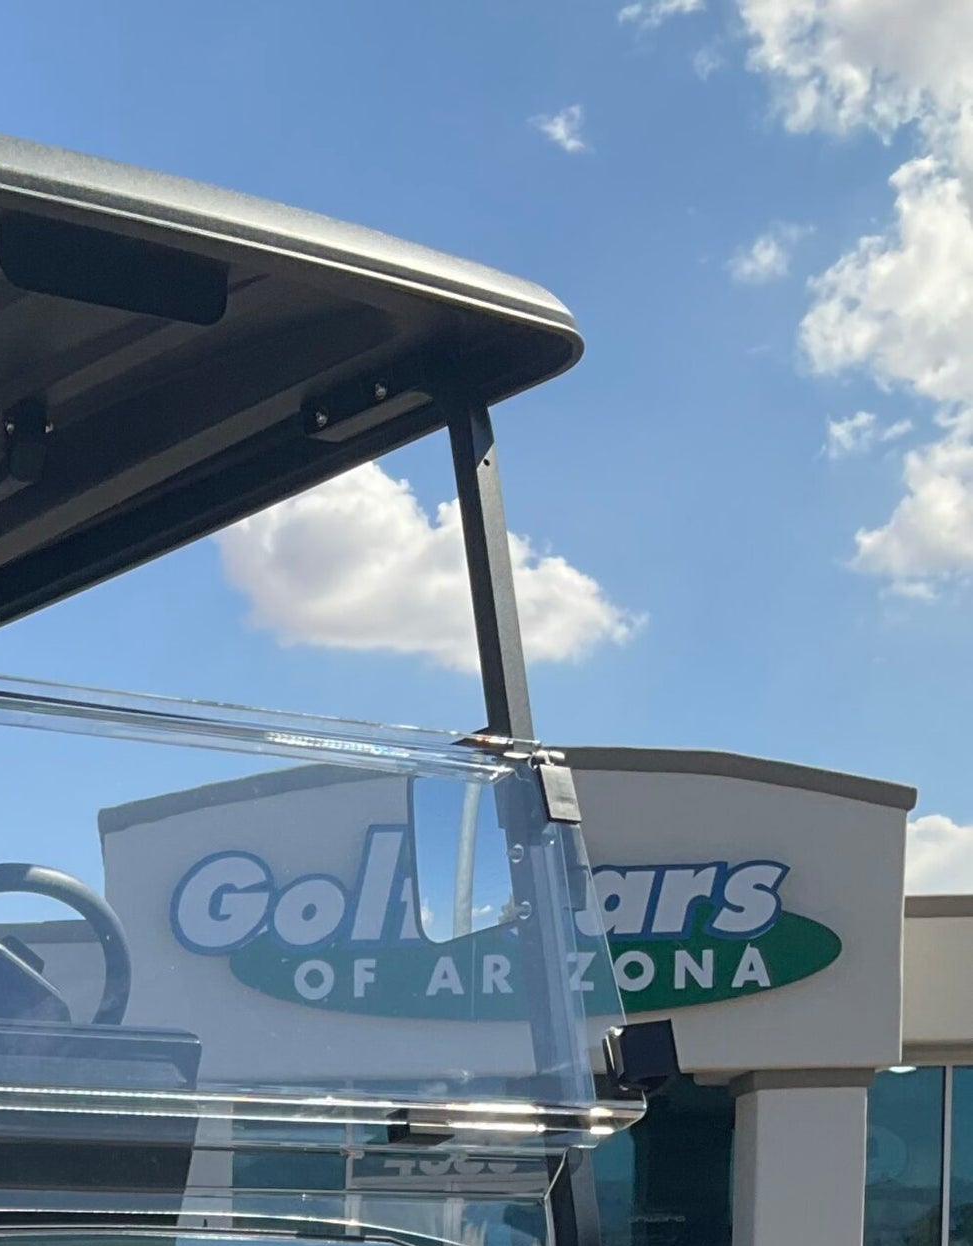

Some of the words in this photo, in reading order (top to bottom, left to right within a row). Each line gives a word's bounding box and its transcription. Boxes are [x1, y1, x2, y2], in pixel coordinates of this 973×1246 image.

[573, 861, 790, 941] ars
[294, 958, 377, 1000] OF
[426, 943, 771, 996] ARZONA
